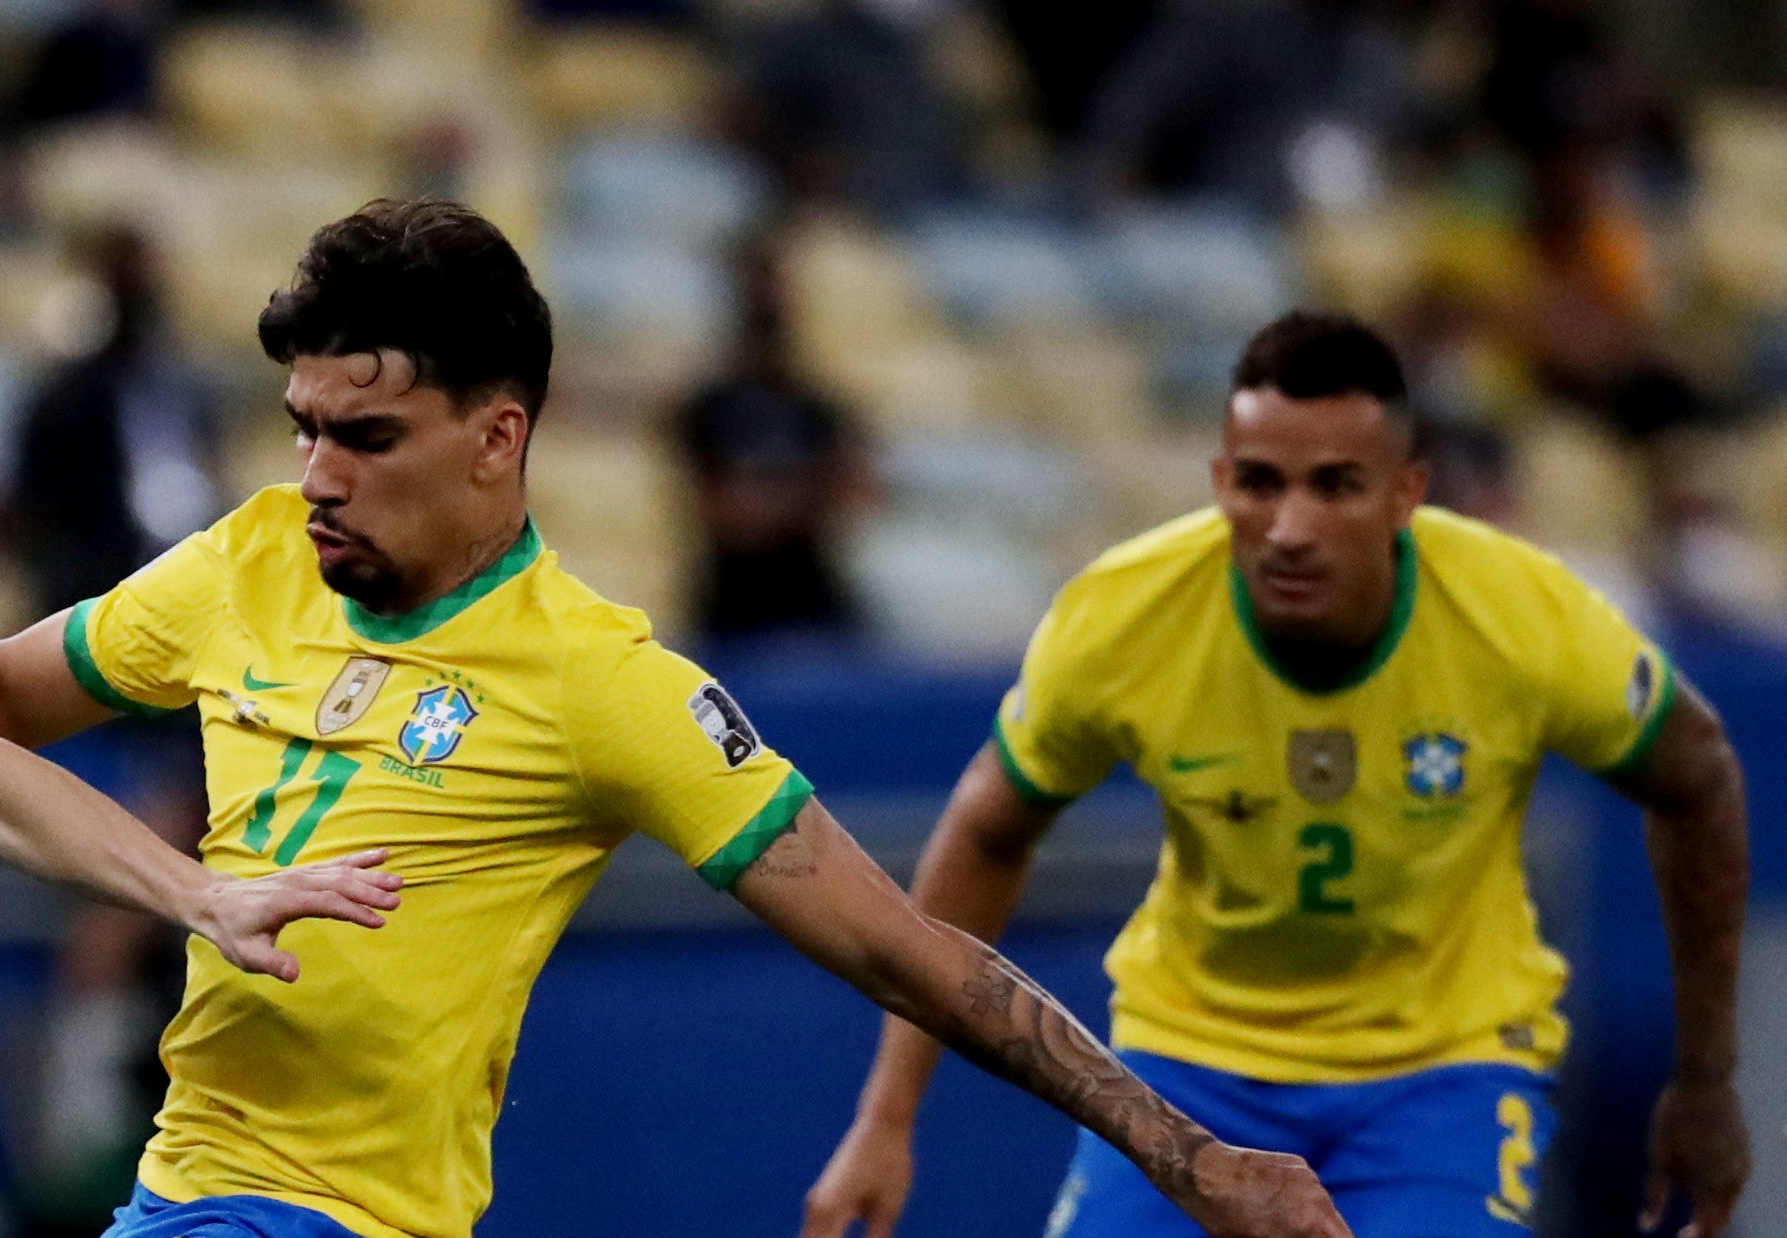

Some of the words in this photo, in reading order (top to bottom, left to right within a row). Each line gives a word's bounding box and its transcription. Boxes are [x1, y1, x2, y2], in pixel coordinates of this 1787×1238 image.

[423, 714, 449, 730] CBF
[241, 736, 362, 867] 17
[377, 753, 445, 790] BRASIL
[1296, 821, 1356, 915] 2
